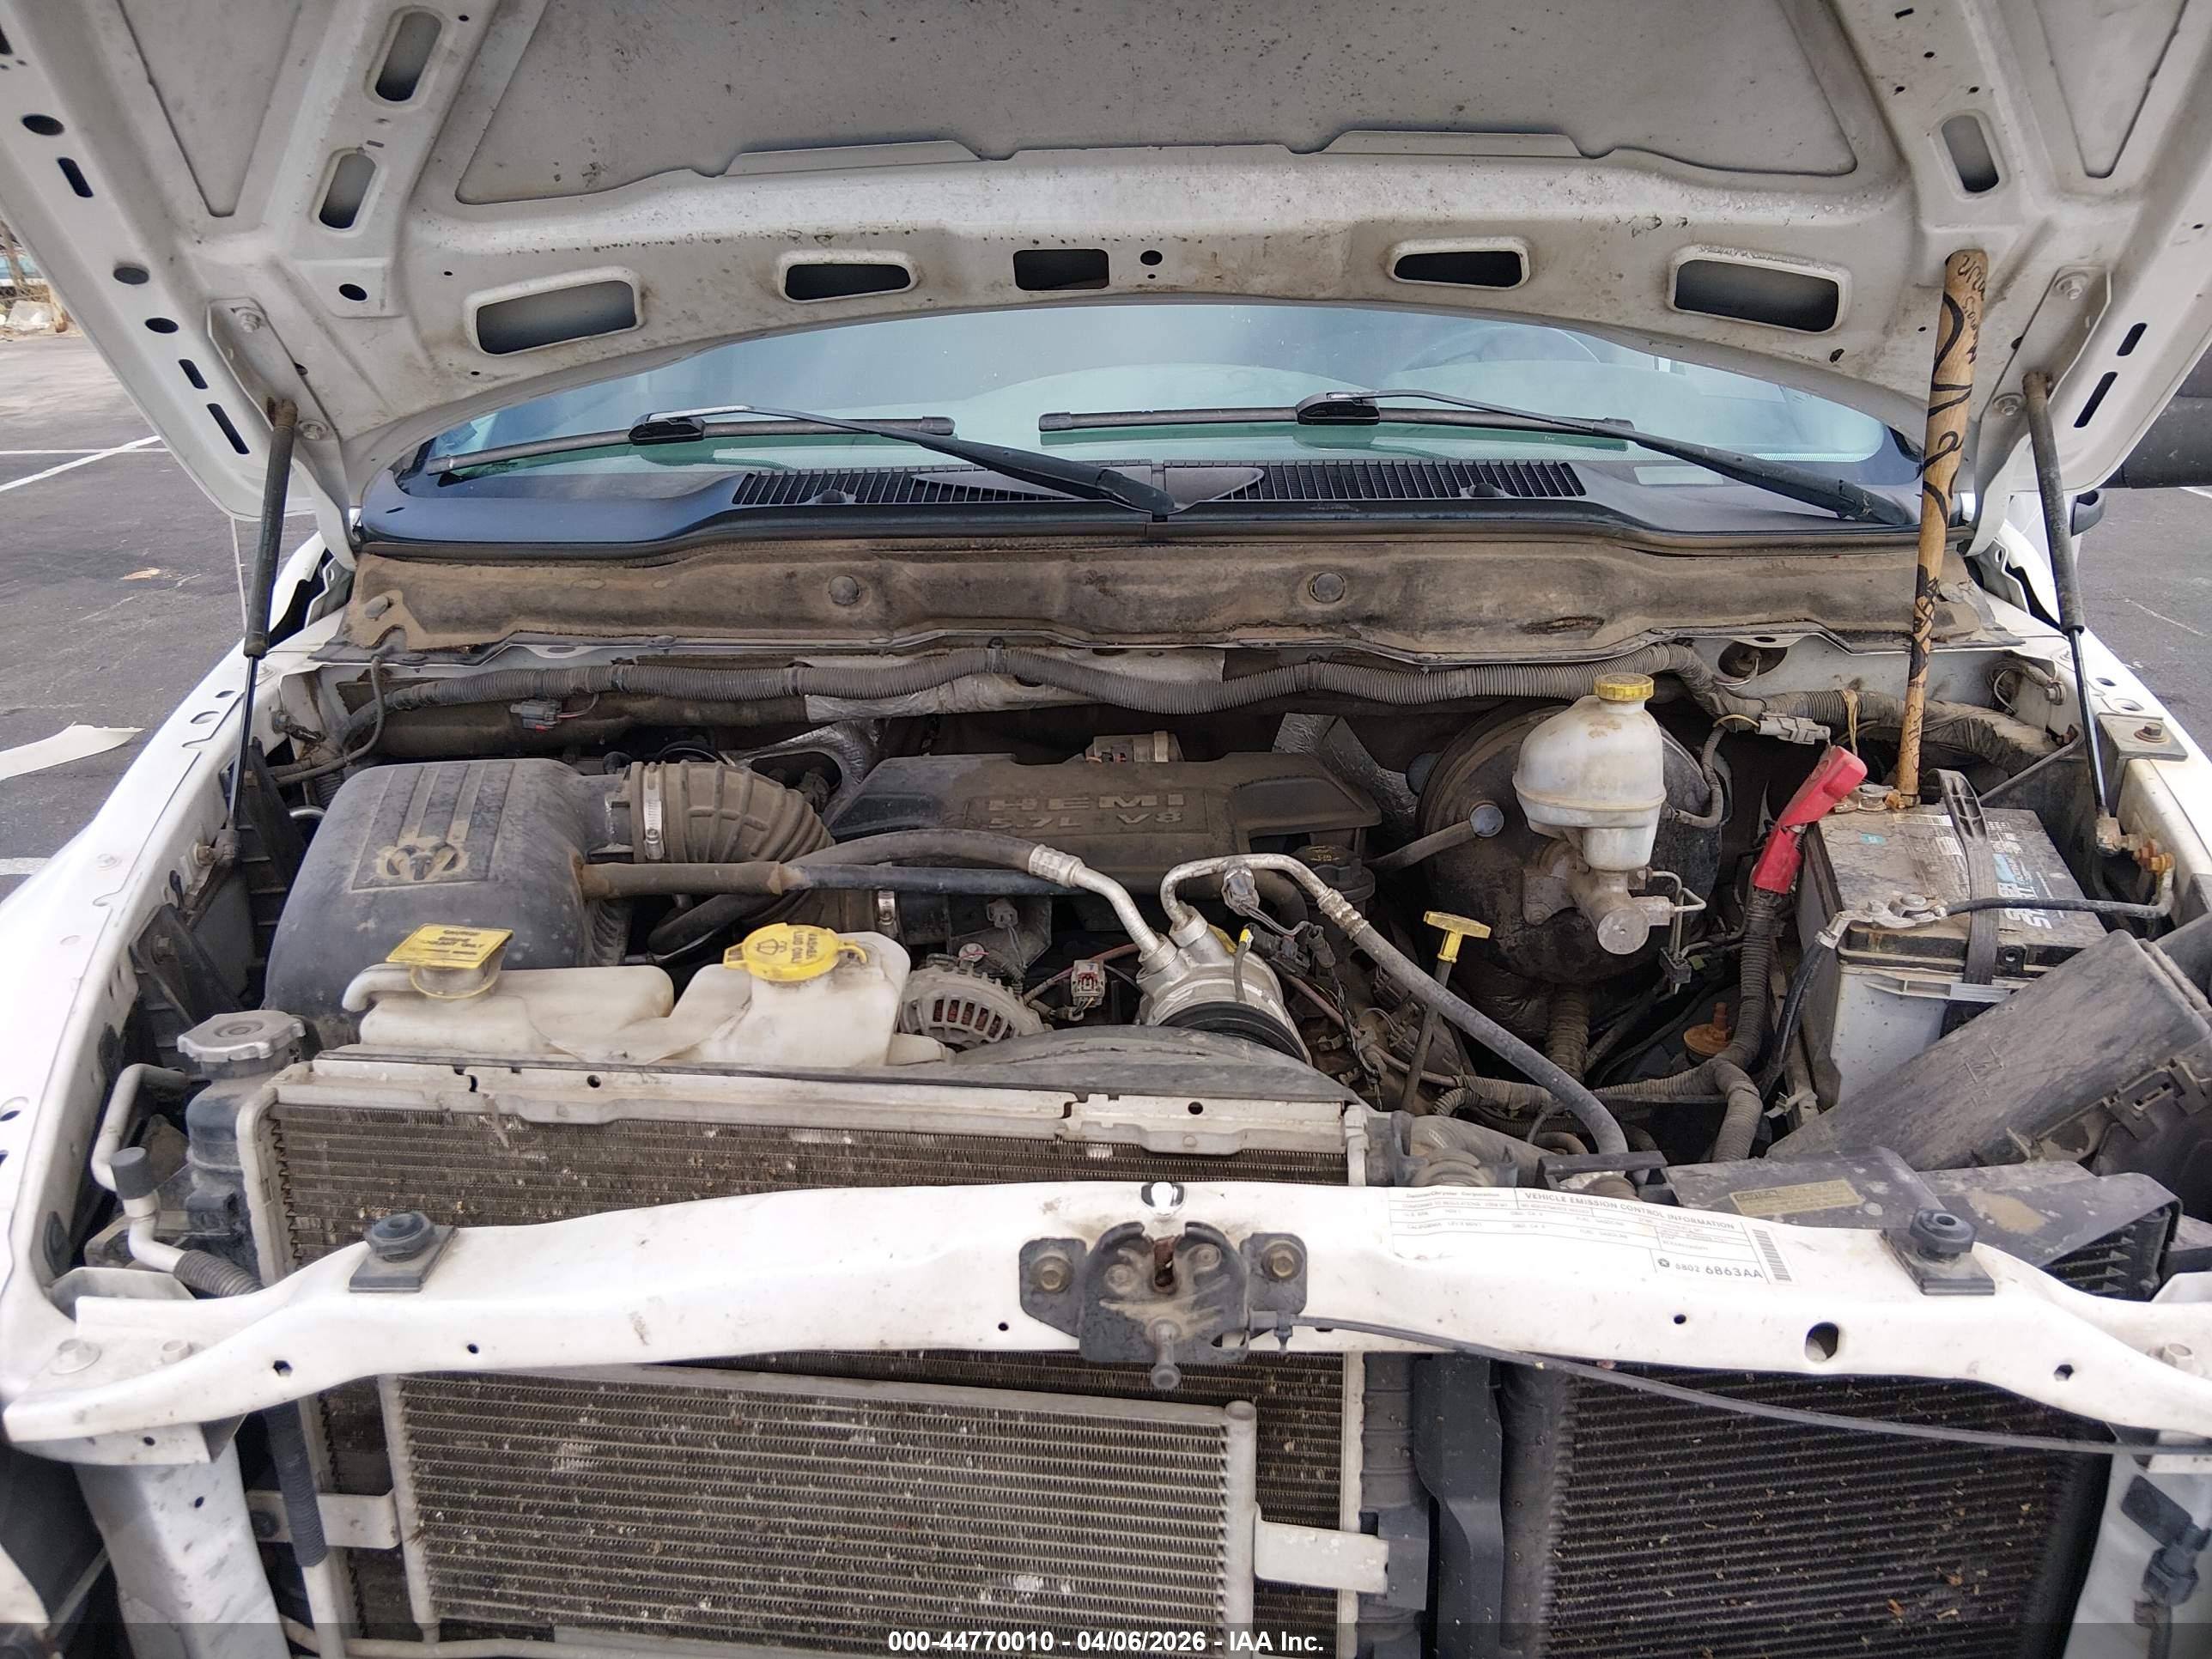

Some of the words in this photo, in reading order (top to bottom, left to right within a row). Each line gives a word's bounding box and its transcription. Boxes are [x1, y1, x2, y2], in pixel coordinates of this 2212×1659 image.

[988, 793, 1184, 811] HEMI
[988, 817, 1082, 830] 5.7L
[1118, 811, 1183, 824] V8
[1524, 1192, 1567, 1202] VEHICLE
[1569, 1196, 1619, 1209] EMISSION
[1620, 1203, 1665, 1218] CONTROL
[1667, 1213, 1735, 1230] INFORMATION
[1705, 1266, 1764, 1279] 6863AA
